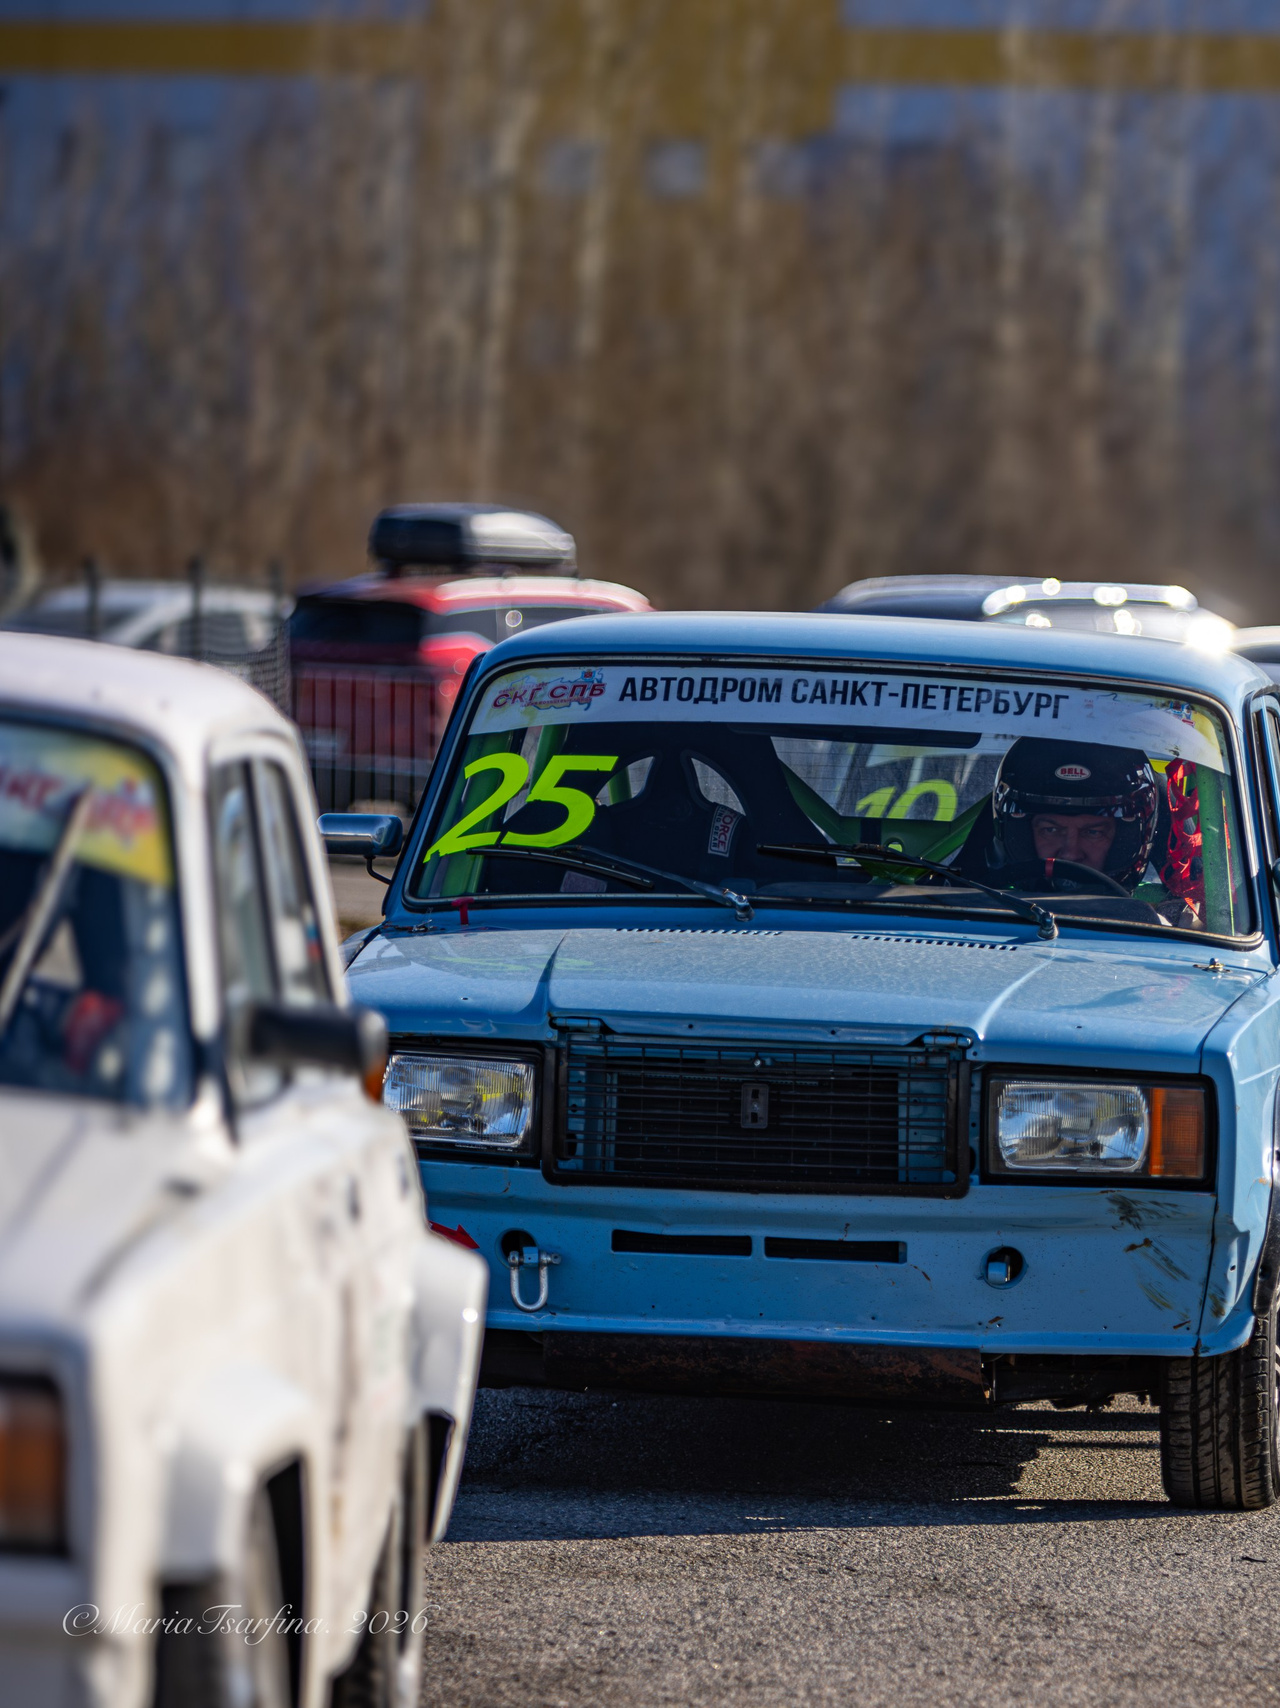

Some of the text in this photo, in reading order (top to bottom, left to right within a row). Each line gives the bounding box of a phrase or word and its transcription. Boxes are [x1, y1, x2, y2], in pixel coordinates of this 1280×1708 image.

[492, 687, 543, 709] СКГ
[549, 682, 607, 699] СПБ
[618, 676, 1070, 719] АВТОДРОМ САНКТ-ПЕТЕРБУРГ
[1060, 767, 1087, 776] BELL
[422, 752, 619, 864] 25
[711, 825, 720, 848] GEAR
